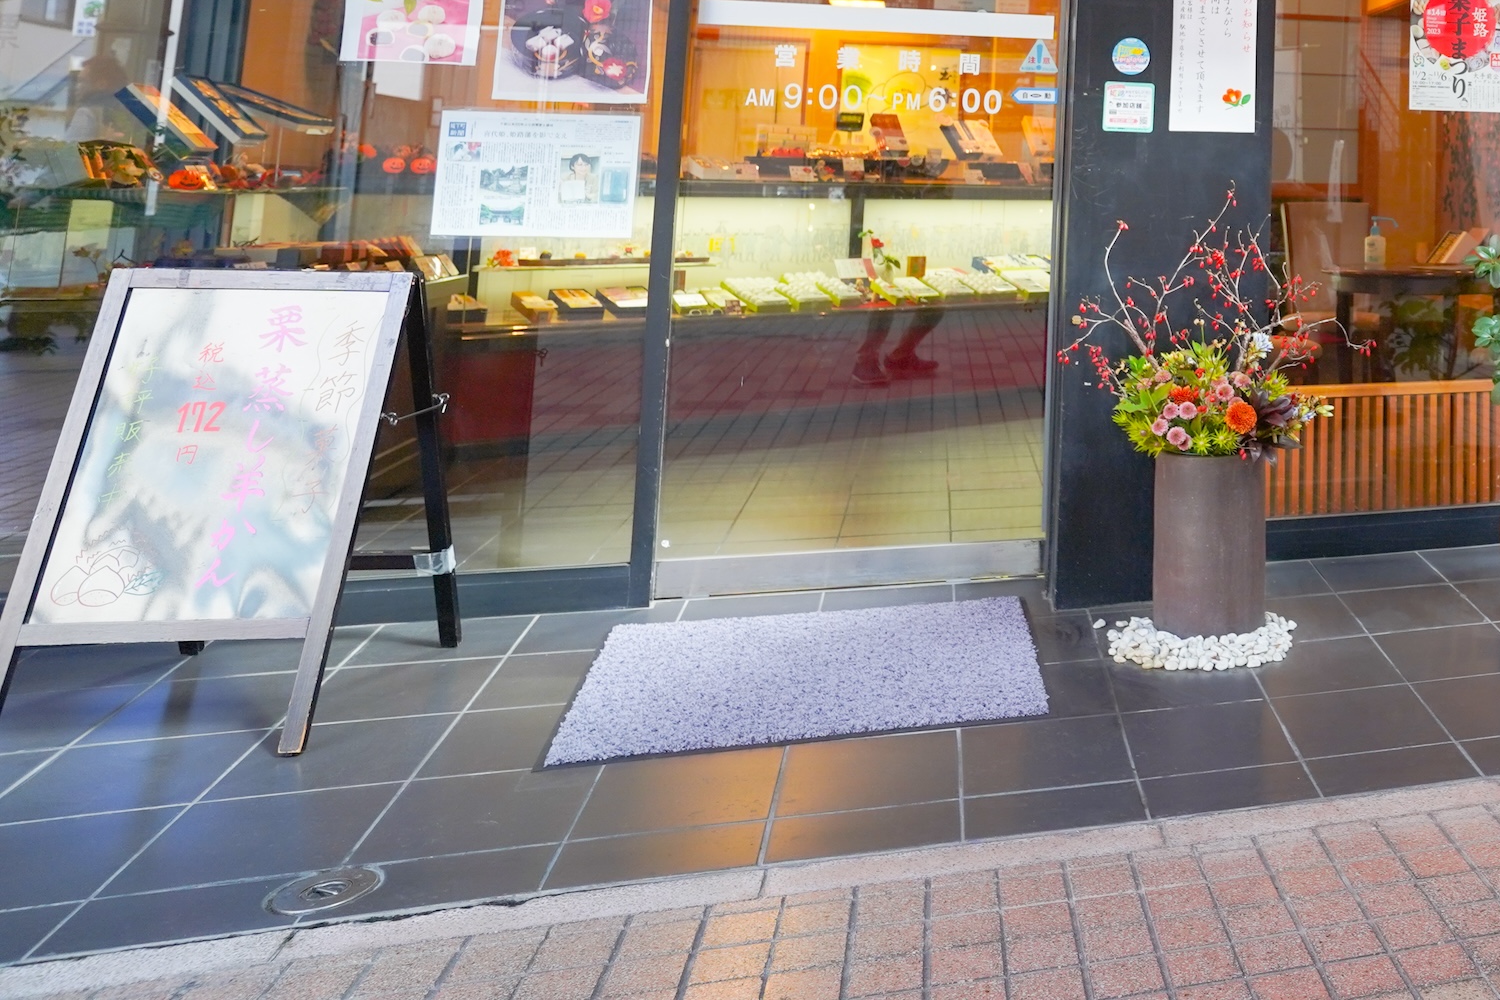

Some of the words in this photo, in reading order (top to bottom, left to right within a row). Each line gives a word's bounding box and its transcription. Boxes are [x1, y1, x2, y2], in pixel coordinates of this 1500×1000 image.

[1471, 7, 1489, 37] 姫路
[774, 44, 981, 75] 営業時間
[745, 88, 775, 107] AM
[784, 83, 863, 110] 9:00
[892, 92, 921, 111] PM
[928, 88, 1003, 115] 6:00
[195, 304, 308, 589] 栗蒸し羊かん
